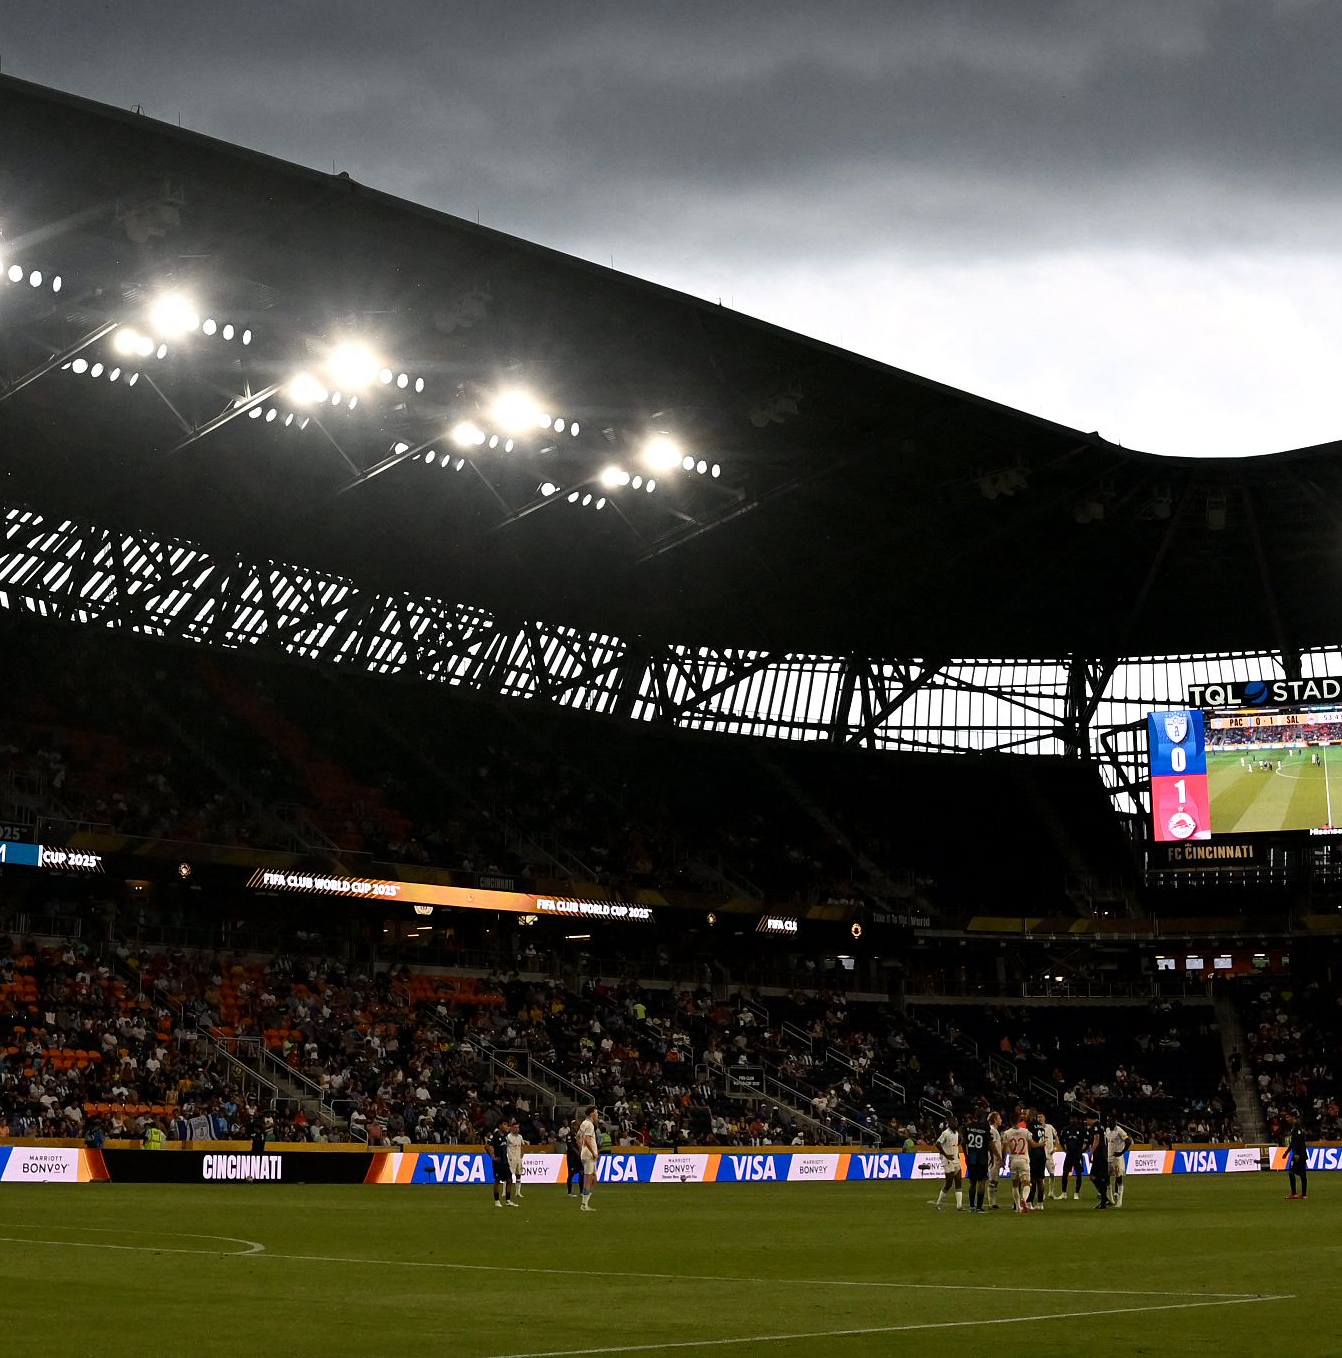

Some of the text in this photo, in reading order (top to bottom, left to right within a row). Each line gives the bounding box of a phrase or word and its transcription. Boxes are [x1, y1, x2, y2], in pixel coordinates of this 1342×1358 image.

[1189, 684, 1241, 707] TQL
[1229, 718, 1243, 727] PAC
[1255, 717, 1261, 726] 0
[1268, 717, 1273, 725] 1
[1286, 715, 1299, 724] SAL
[1171, 748, 1186, 772] 0
[1173, 779, 1186, 803] 1
[1309, 827, 1342, 836] Hisense
[42, 850, 67, 864] CUP
[1168, 846, 1253, 861] FC CINCINNATI
[263, 872, 286, 886] FIFA
[287, 875, 313, 889] CLUB
[313, 878, 351, 892] WORLD
[351, 881, 372, 894] CUP
[536, 898, 556, 911] FIFA
[556, 900, 579, 913] CLUB
[579, 902, 610, 915] WORLD
[610, 906, 628, 917] CUP
[767, 919, 784, 930] FIFA
[967, 1133, 984, 1149] 29
[1009, 1138, 1026, 1155] 22
[22, 1163, 68, 1174] BONVOY
[202, 1154, 283, 1180] CINCINNATI
[428, 1154, 486, 1182] VISA
[664, 1164, 696, 1173] BONVOY
[728, 1155, 777, 1181] VISA
[857, 1154, 901, 1179] VISA
[1180, 1151, 1218, 1172] VISA
[1234, 1158, 1255, 1167] BONVO
[521, 1167, 548, 1176] ONVOY
[799, 1166, 828, 1174] BONVOY
